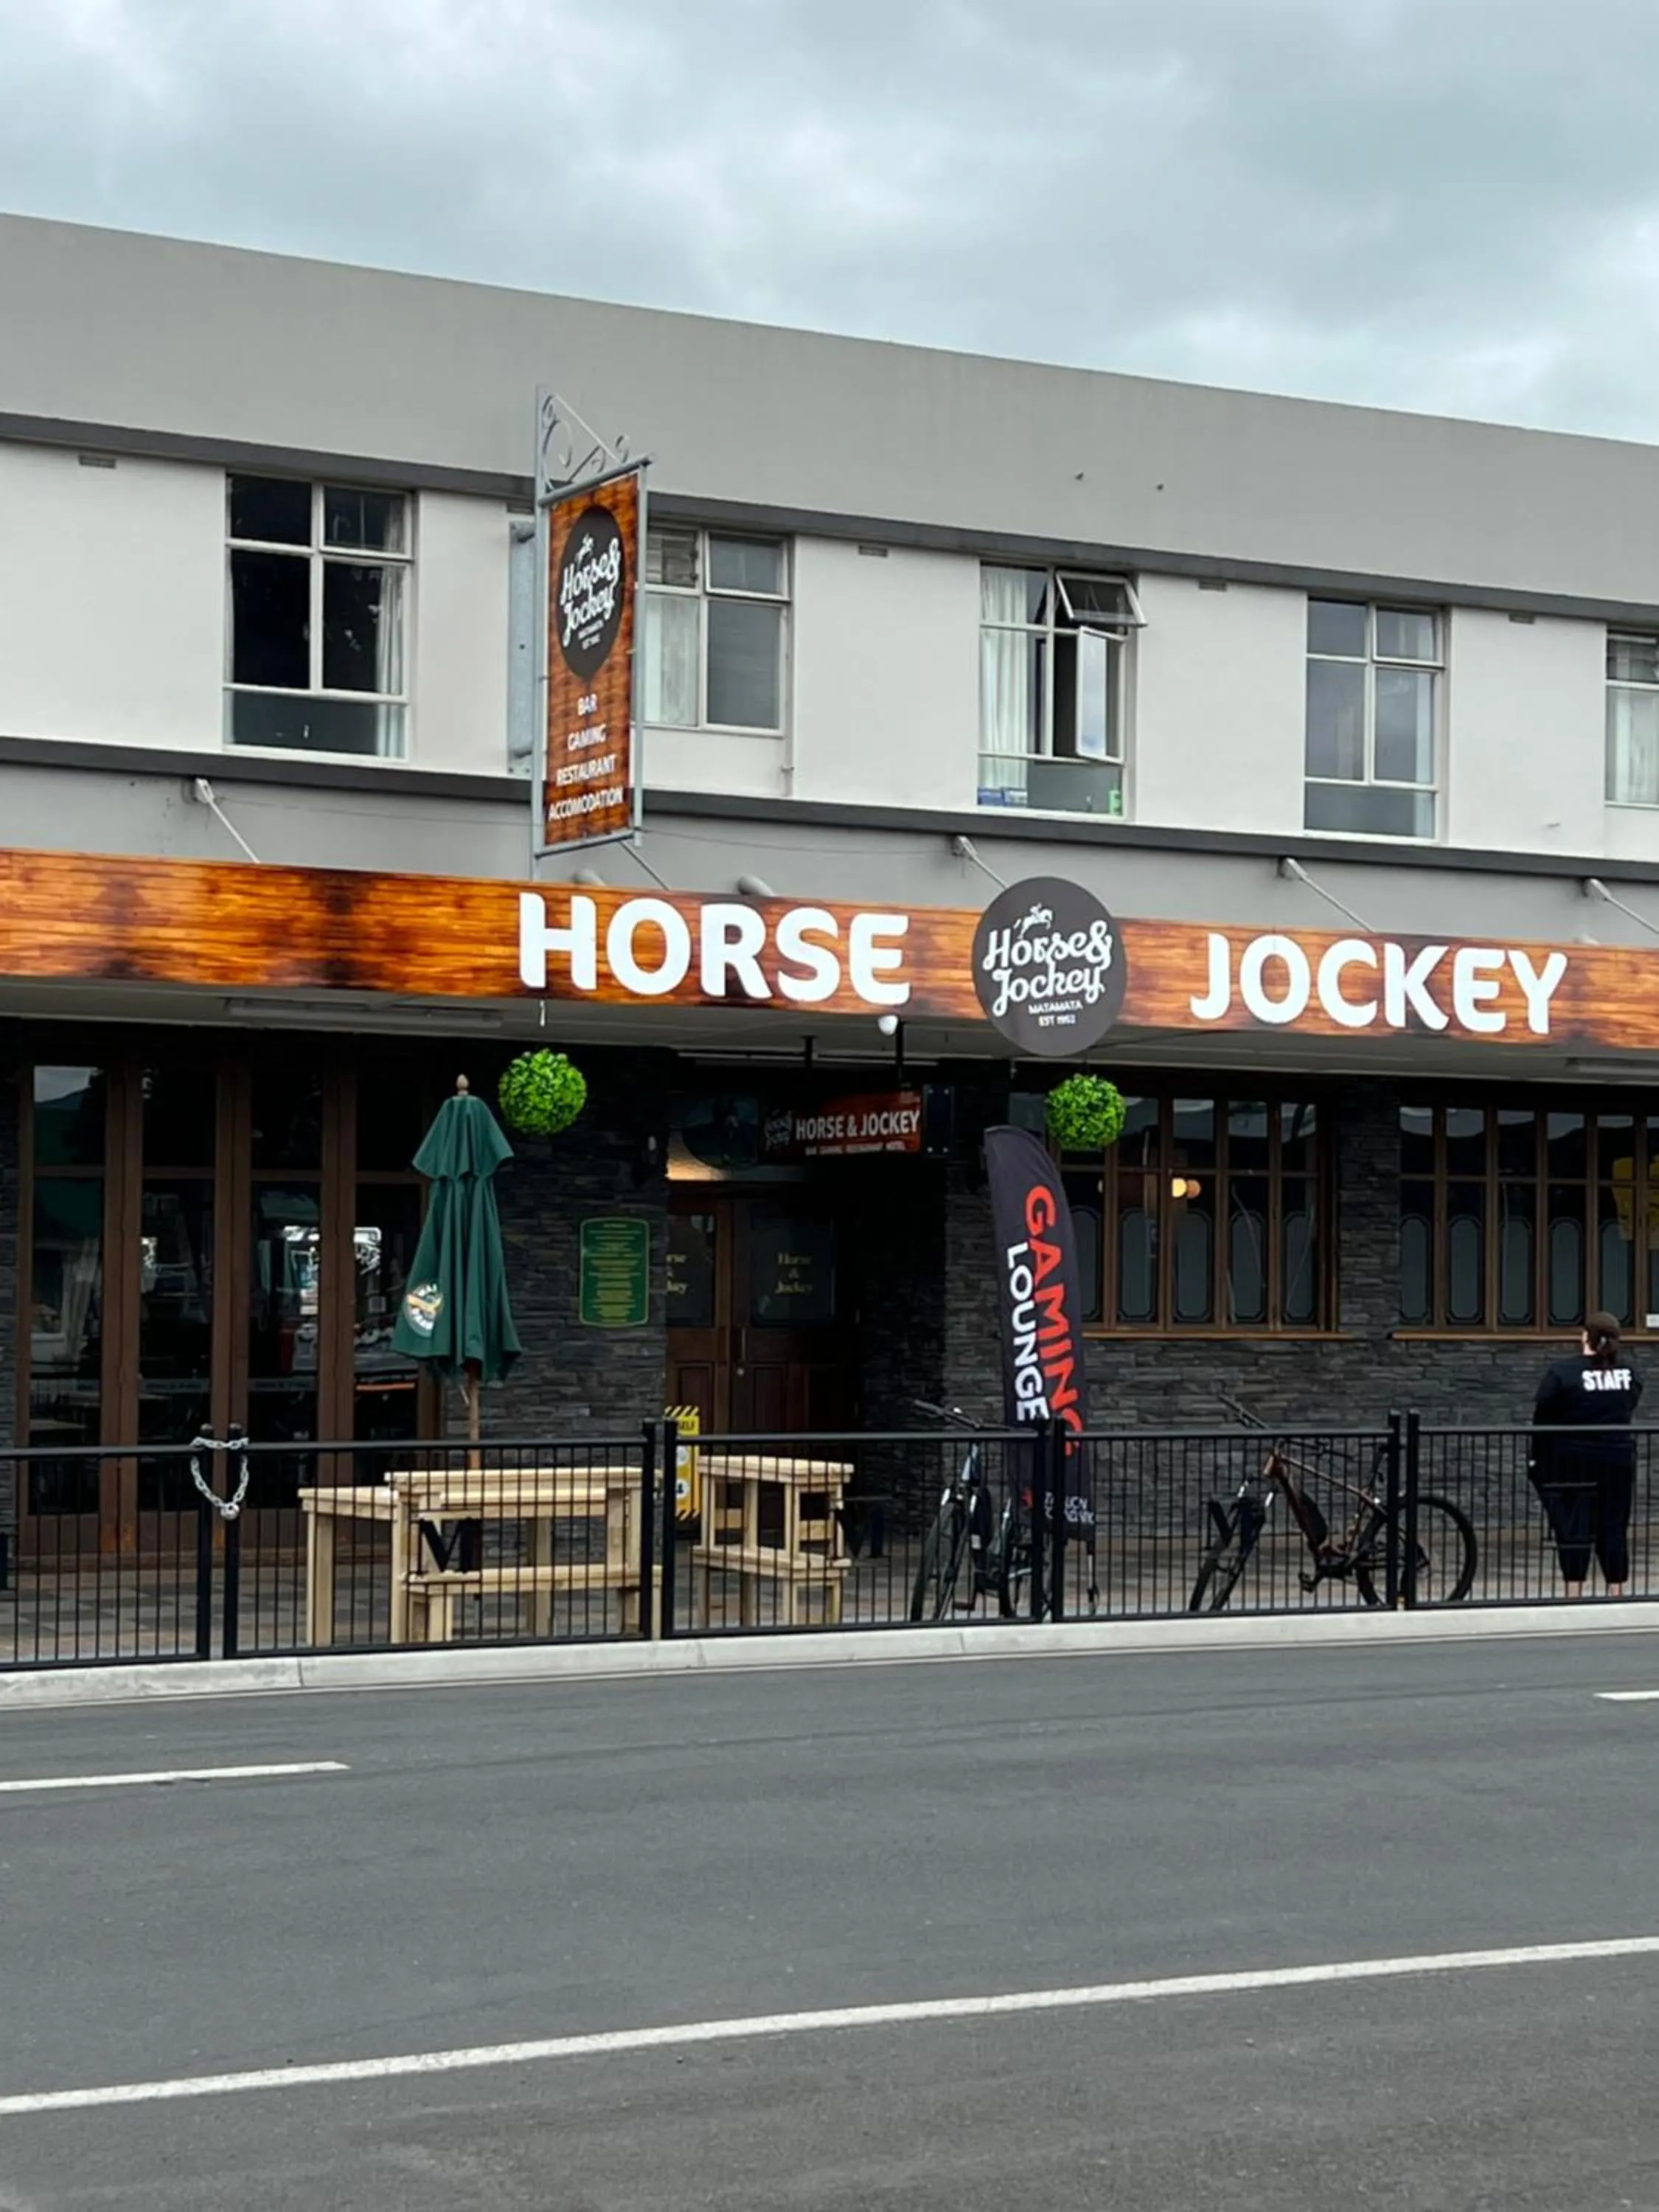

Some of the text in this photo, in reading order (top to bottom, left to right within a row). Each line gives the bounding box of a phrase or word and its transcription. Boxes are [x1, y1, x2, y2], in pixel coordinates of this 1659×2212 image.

[578, 693, 597, 716] BAR
[567, 723, 607, 751] GAMING
[556, 754, 616, 786] RESTAURANT
[549, 787, 623, 822] ACCOMODATION
[519, 891, 1568, 1034] HORSE JOCKEY
[992, 964, 1105, 1017] Jockey
[1028, 1000, 1083, 1015] MATAMATA
[1038, 1015, 1054, 1026] EST
[796, 1116, 845, 1140] HORSE
[847, 1114, 858, 1137] &
[860, 1109, 921, 1135] JOCKEY
[1007, 1242, 1050, 1421] LOUNGE
[1582, 1368, 1632, 1391] STAFF
